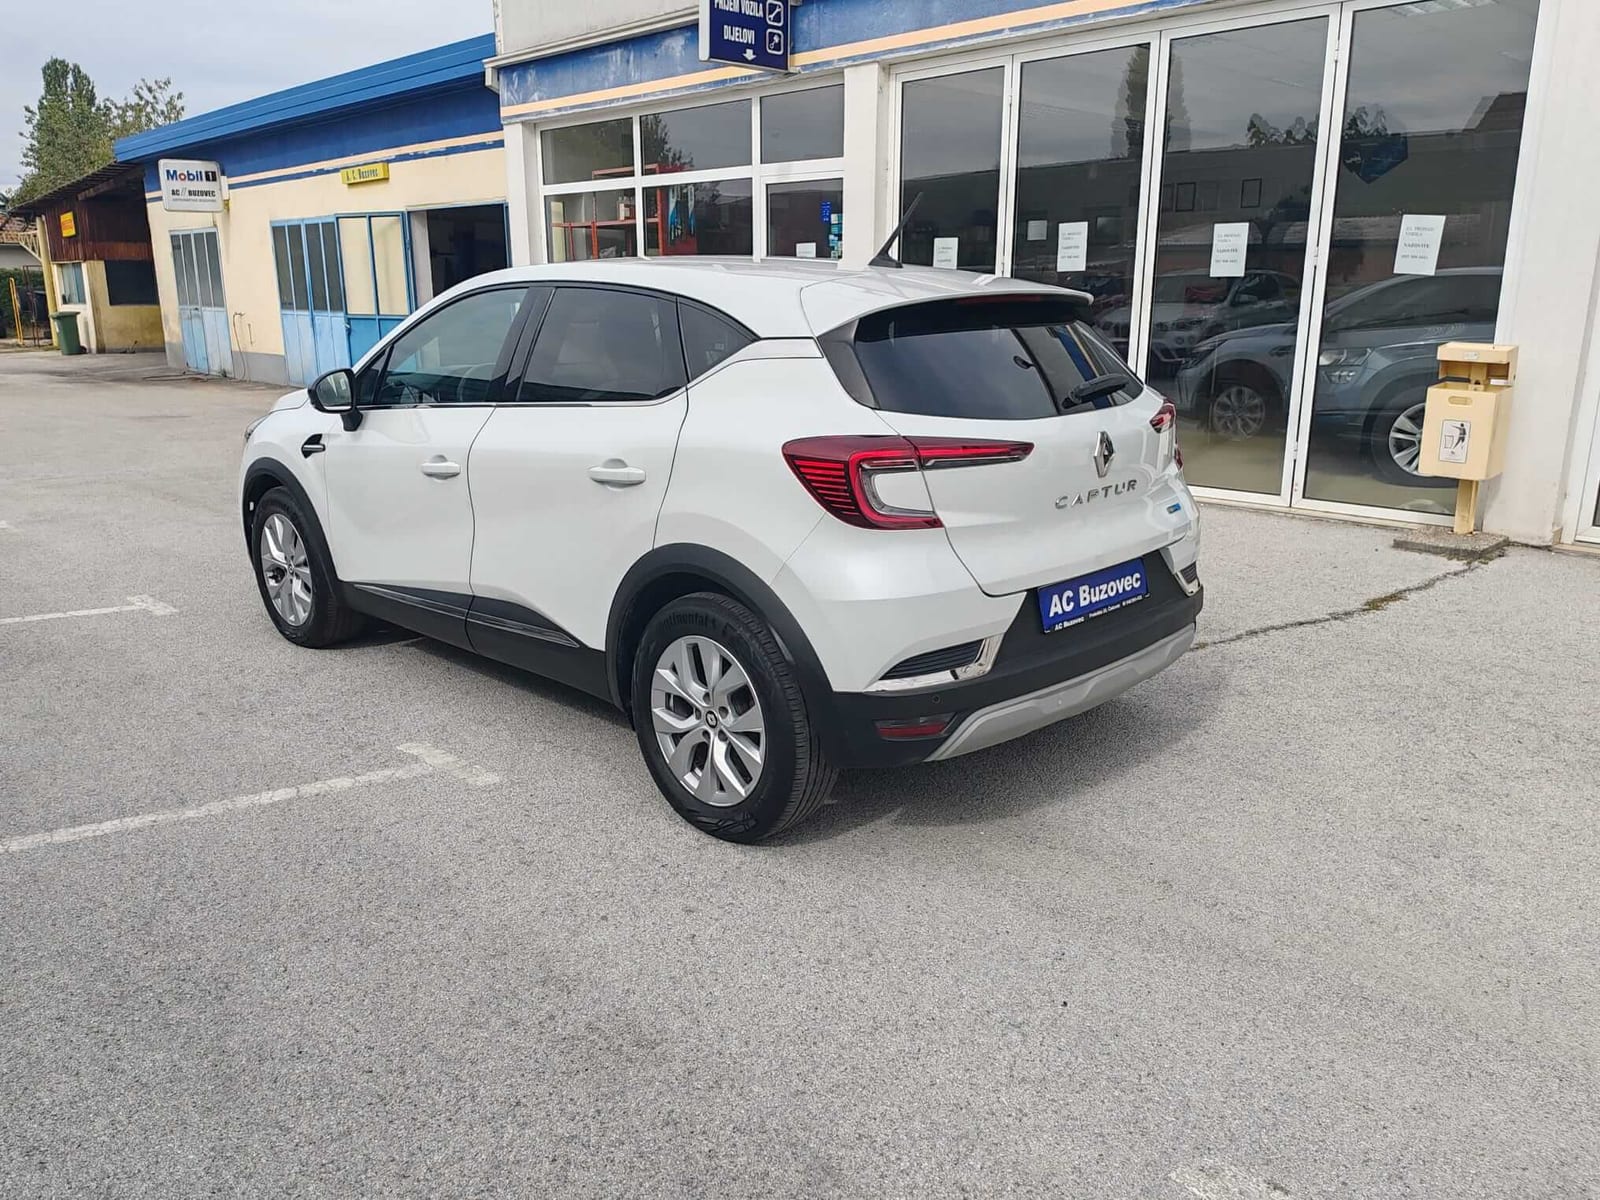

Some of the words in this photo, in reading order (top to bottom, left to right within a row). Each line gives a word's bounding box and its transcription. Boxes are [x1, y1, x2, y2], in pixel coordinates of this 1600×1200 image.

[741, 0, 764, 18] VOZILA
[723, 24, 755, 45] DIJELOVI
[166, 169, 203, 181] Mobil
[188, 189, 216, 197] BUZOVEC
[1055, 479, 1137, 509] CAPTUR
[1049, 590, 1075, 617] AC
[1079, 573, 1142, 607] Buzovec
